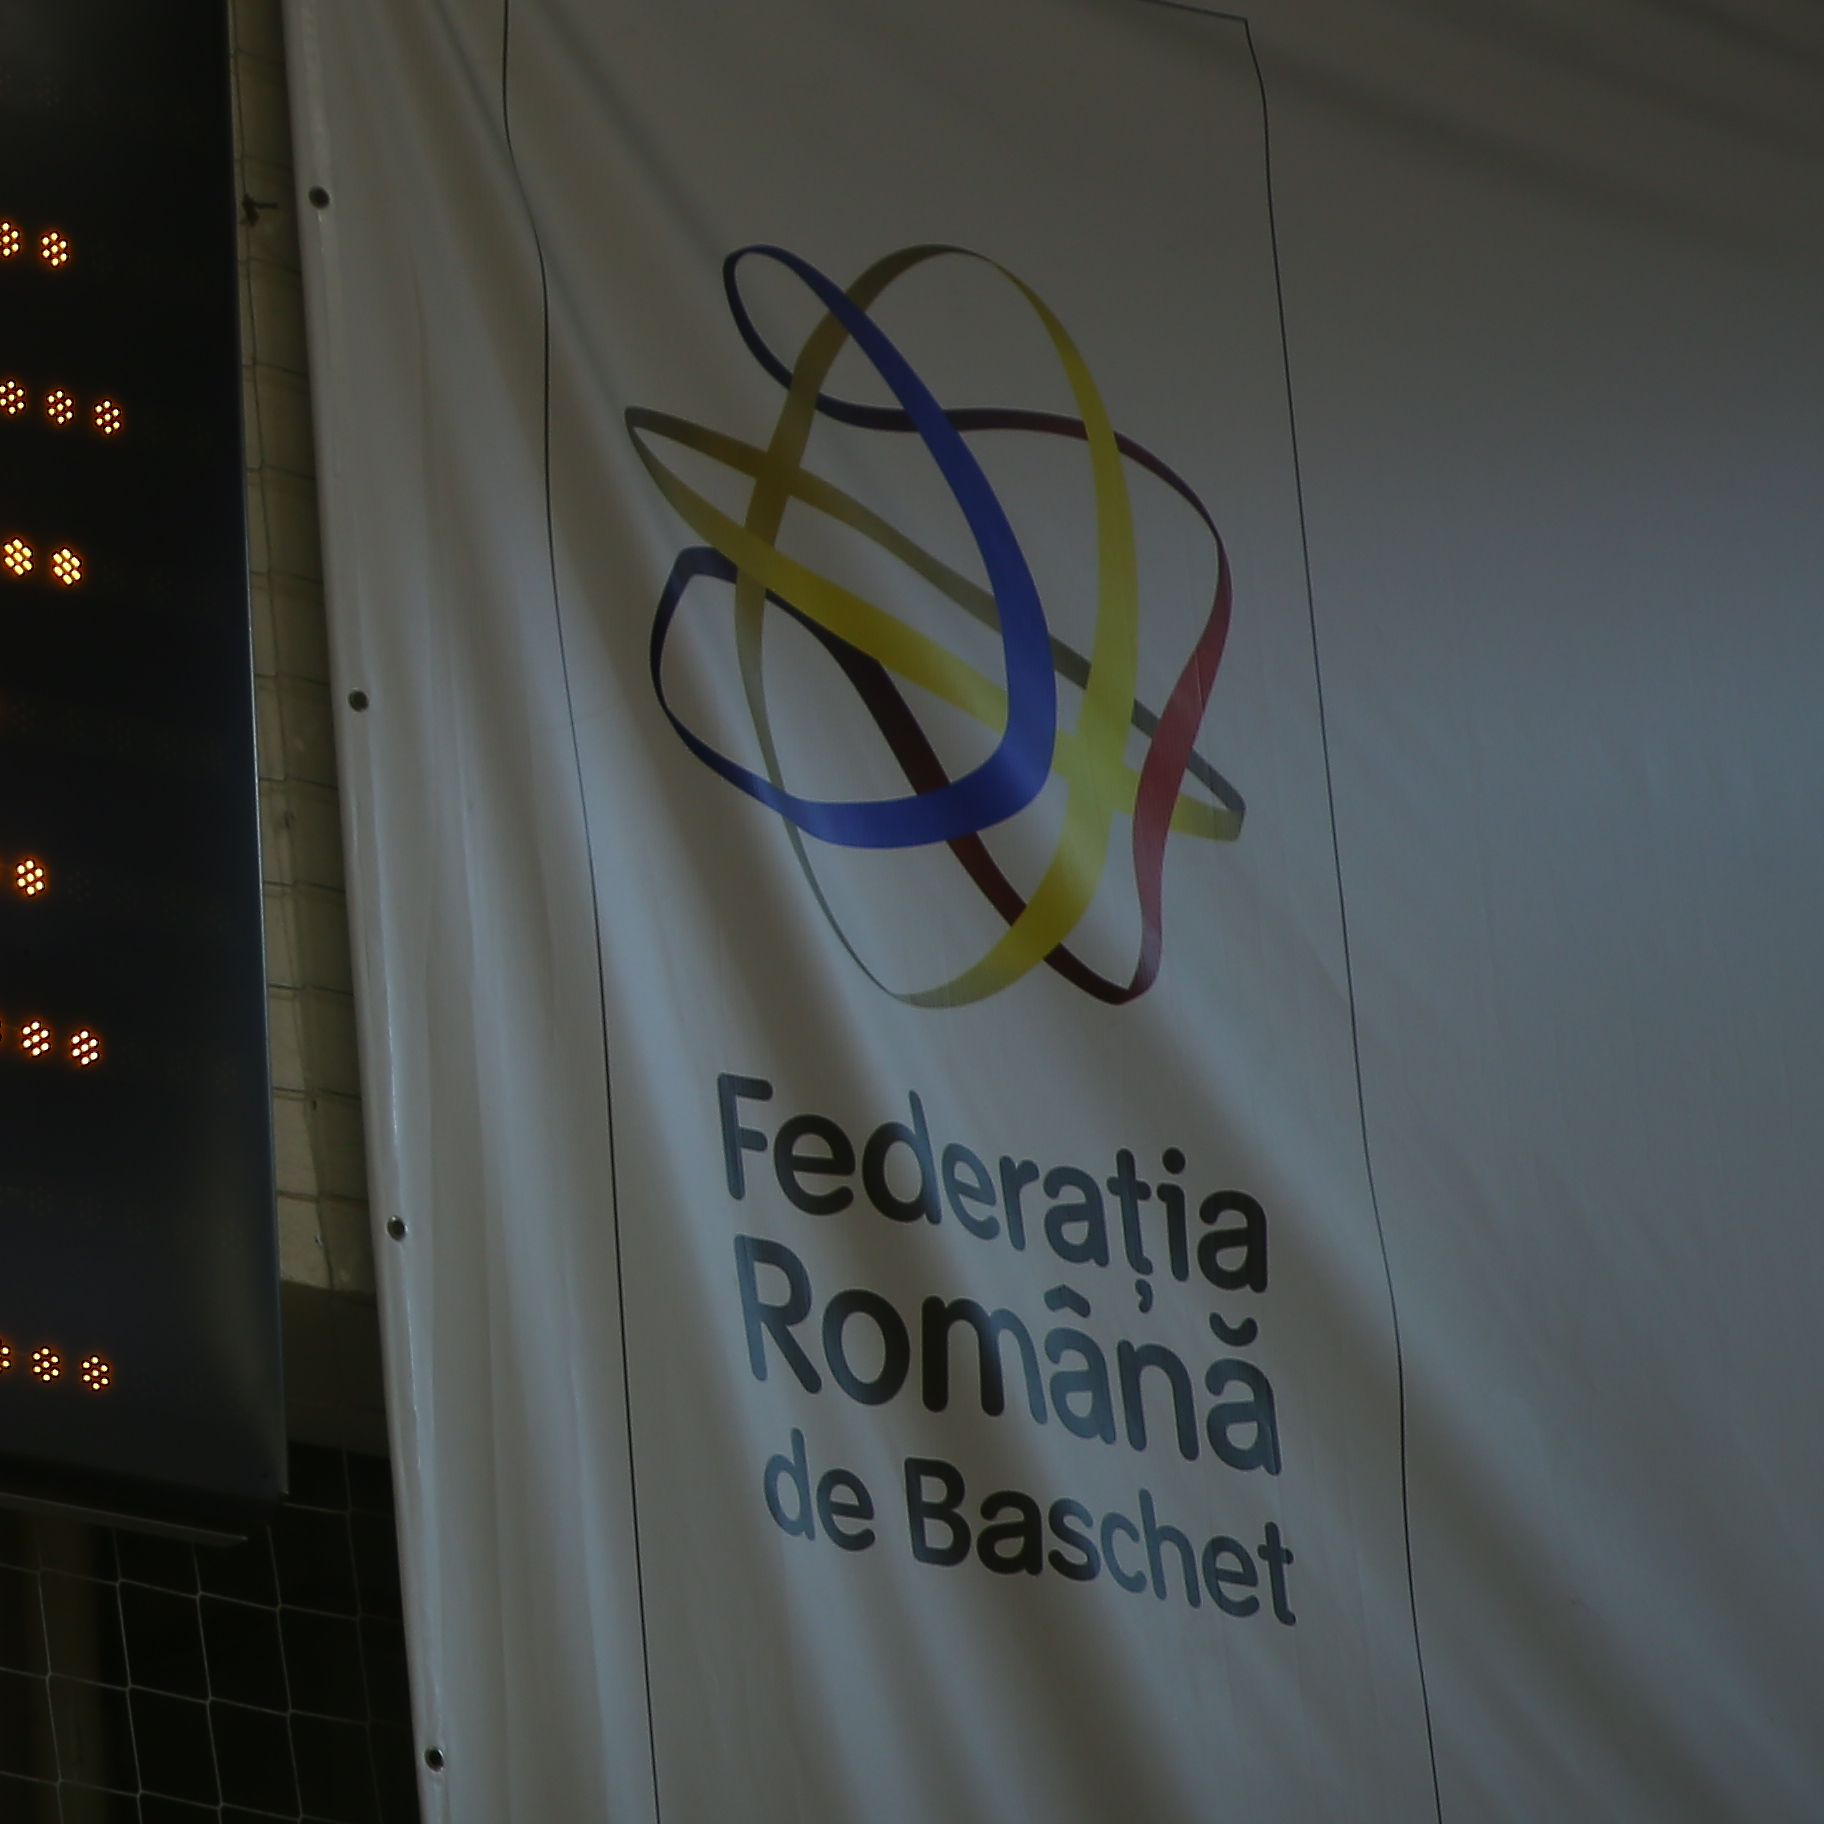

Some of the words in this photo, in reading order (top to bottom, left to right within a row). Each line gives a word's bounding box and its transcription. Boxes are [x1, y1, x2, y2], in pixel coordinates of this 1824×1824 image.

[717, 1073, 1268, 1313] Federația
[734, 1233, 1282, 1476] Română
[763, 1427, 875, 1551] de
[904, 1456, 1296, 1625] Baschet
